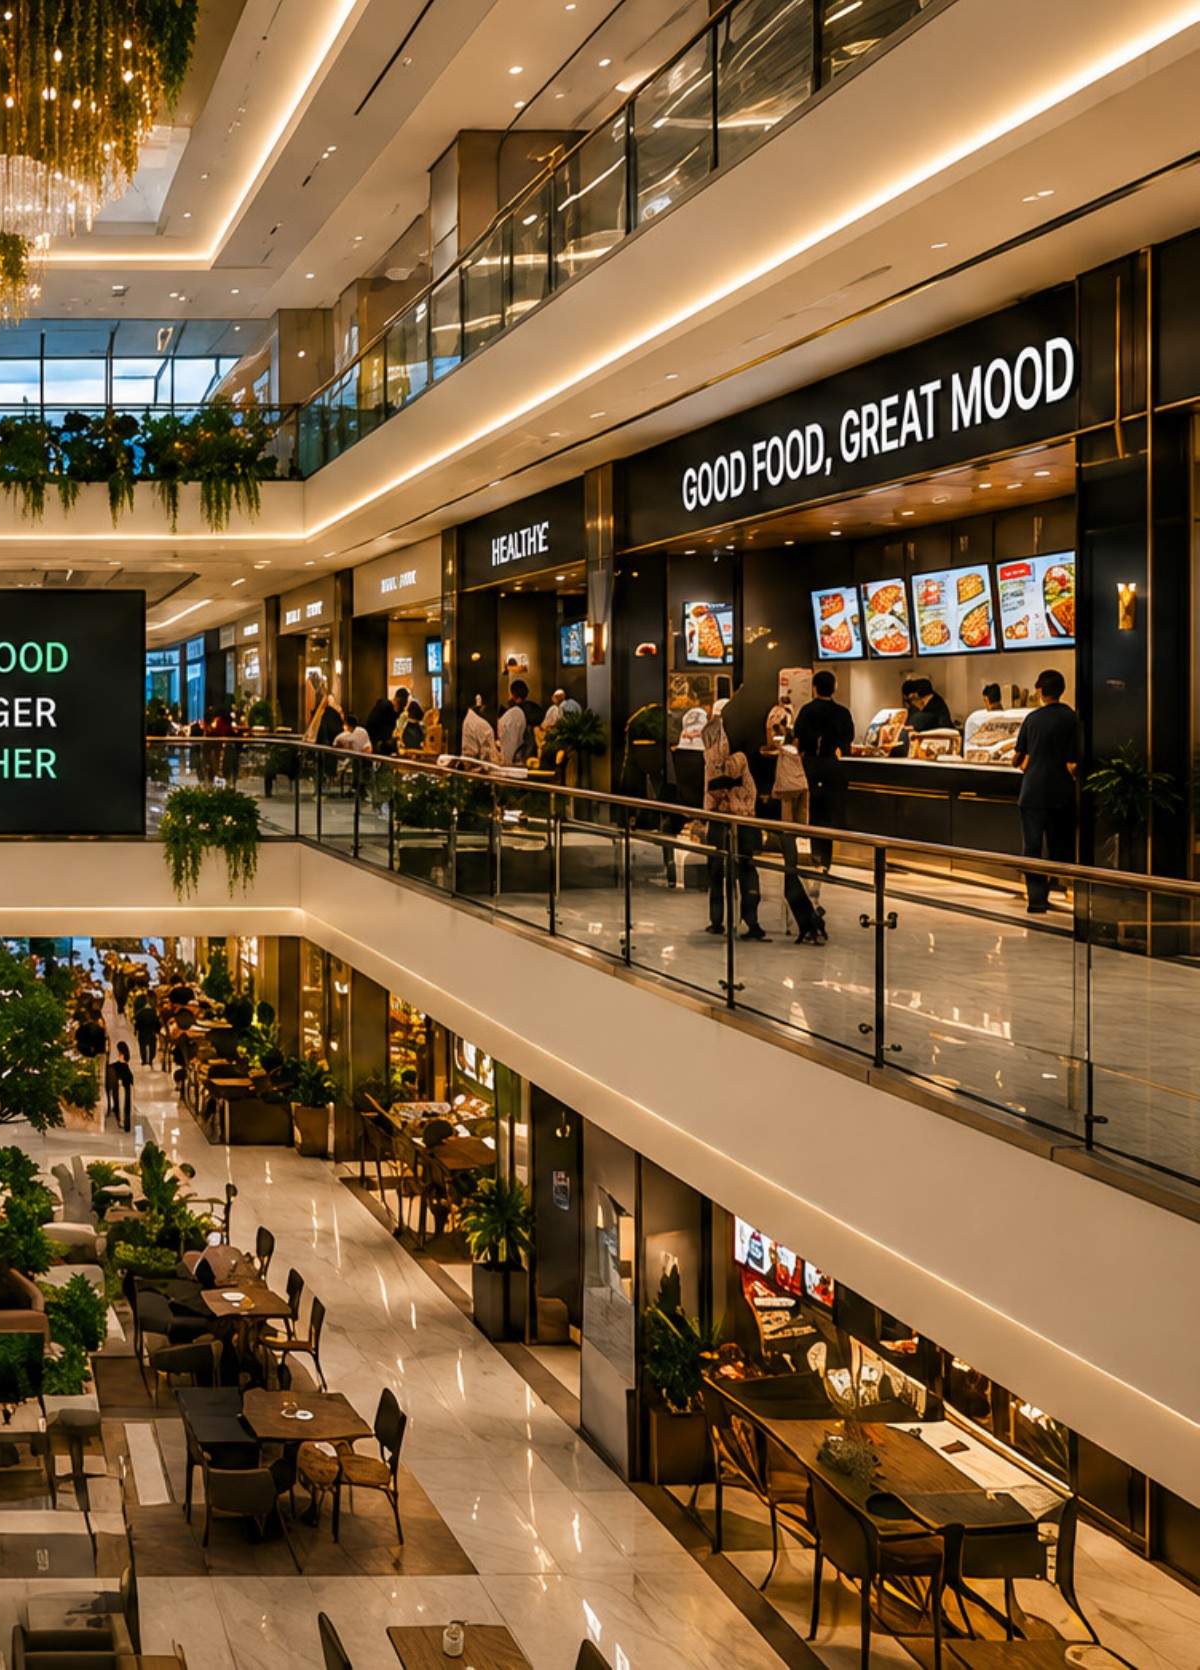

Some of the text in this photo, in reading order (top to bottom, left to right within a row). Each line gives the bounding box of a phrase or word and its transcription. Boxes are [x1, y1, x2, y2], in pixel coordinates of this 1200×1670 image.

[682, 336, 1075, 512] GOOD FOOD, GREAT MOOD
